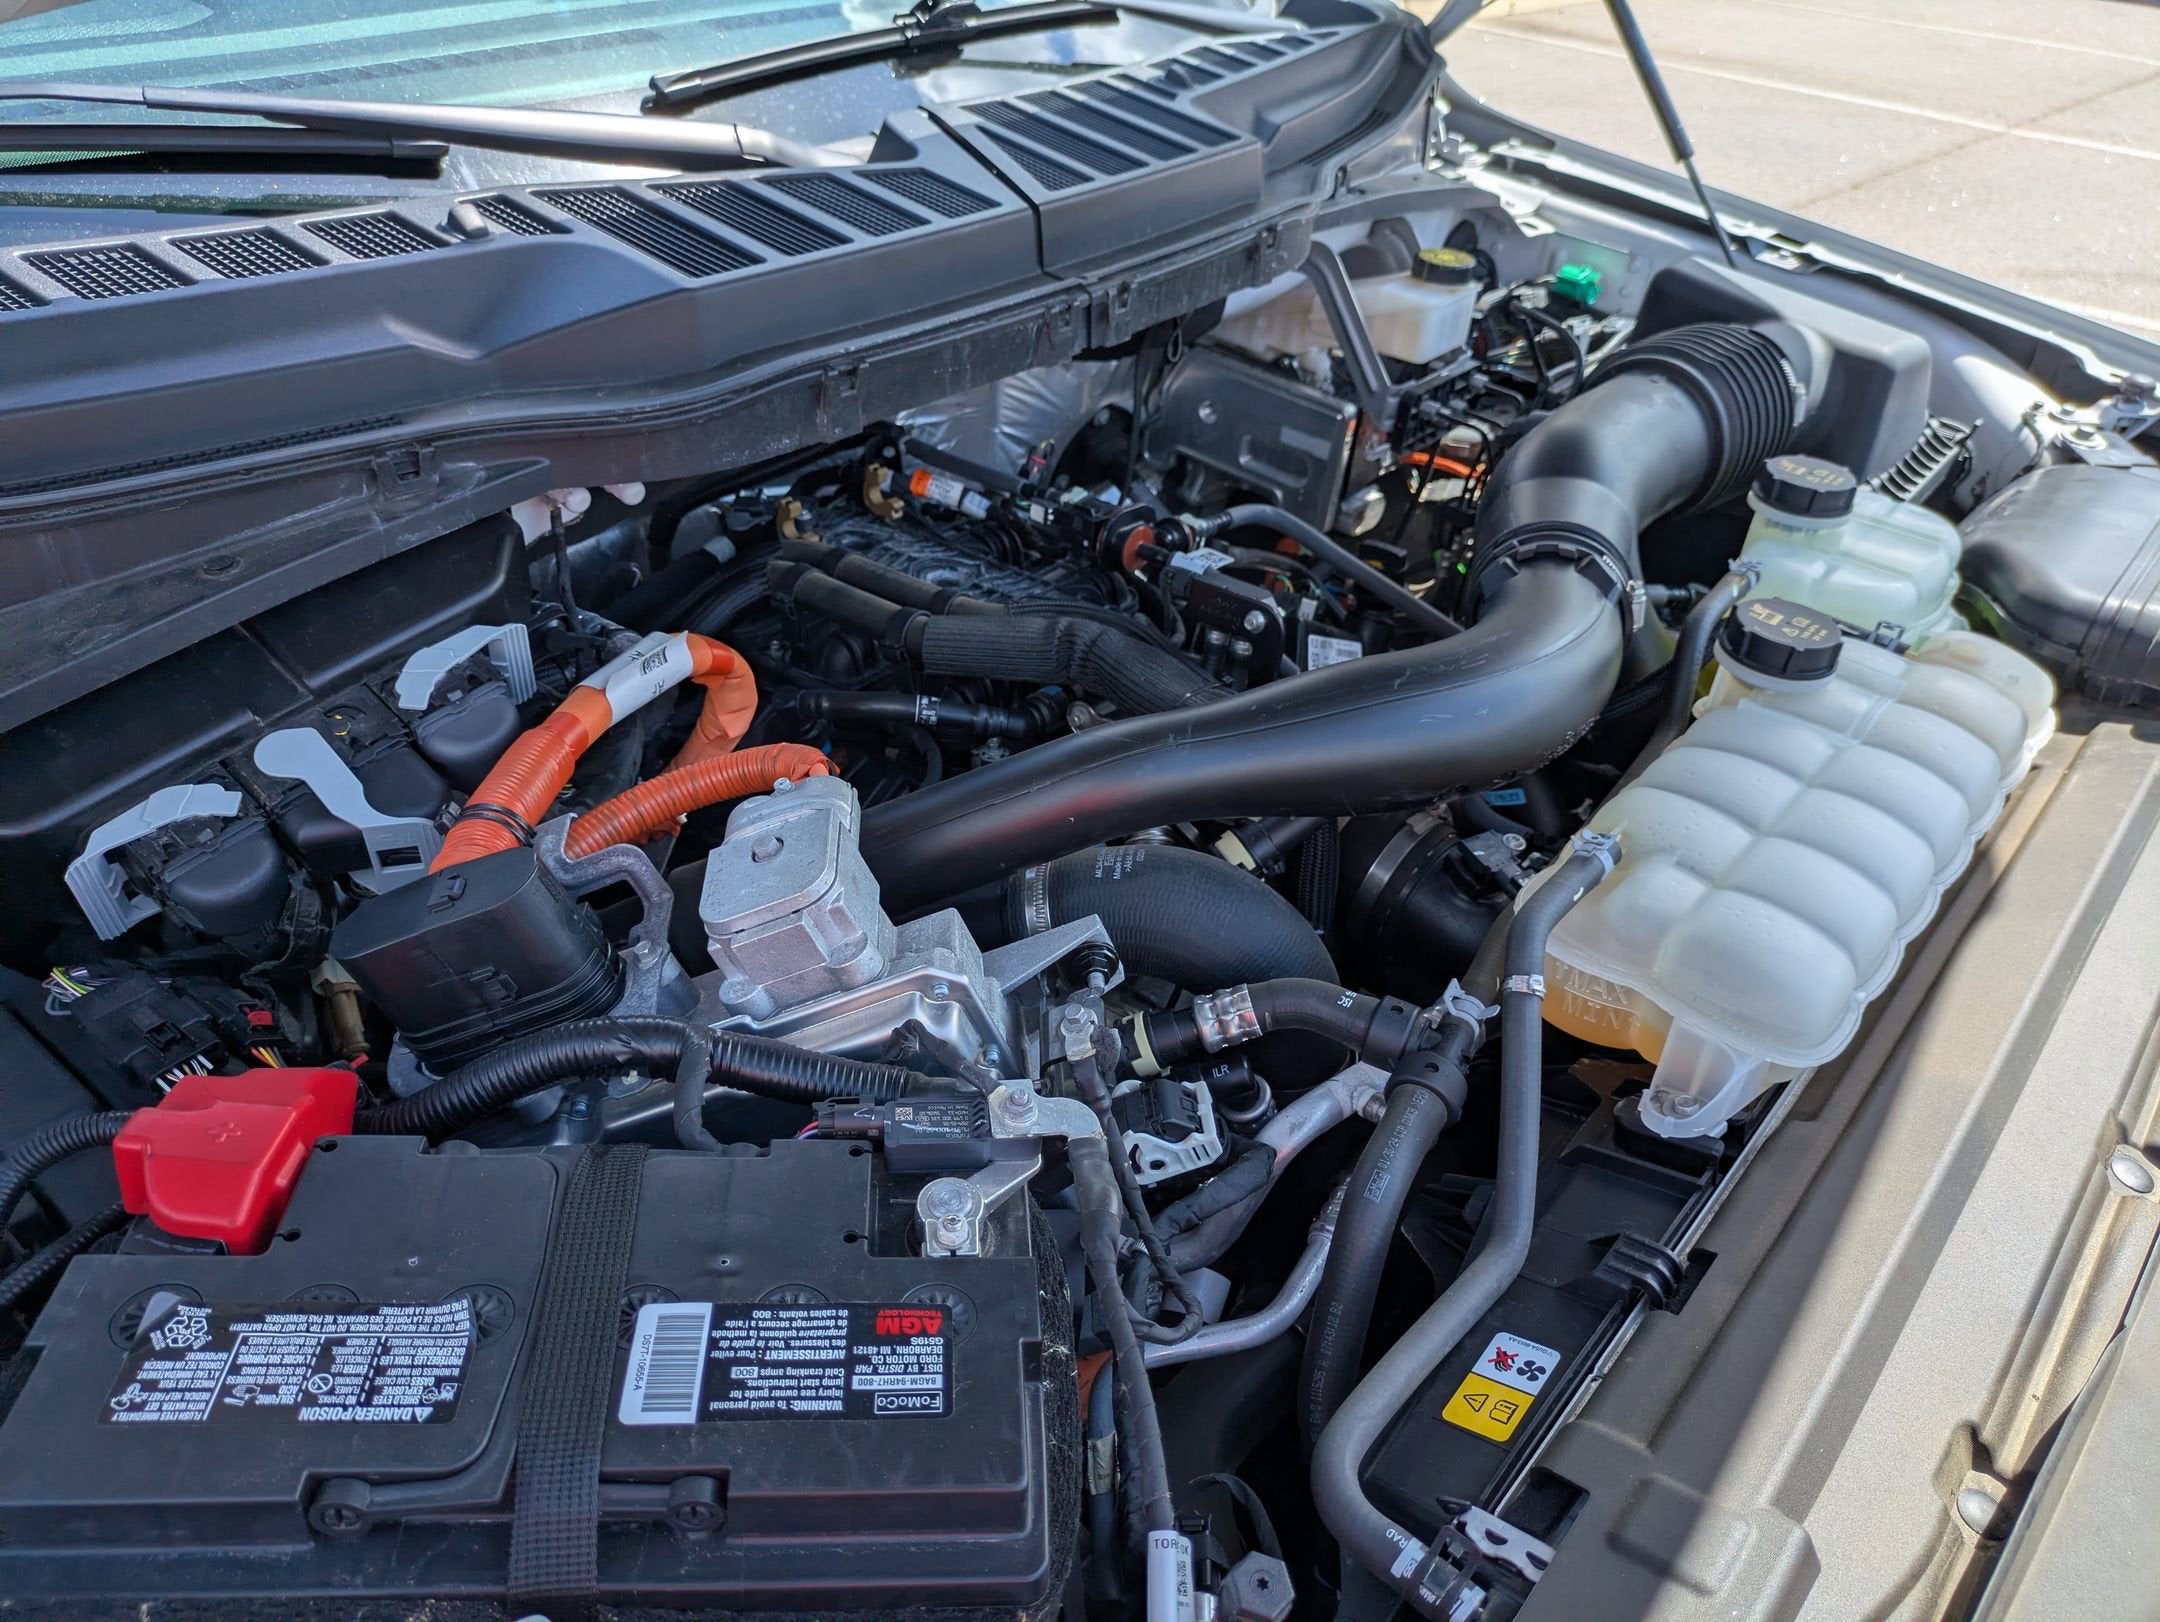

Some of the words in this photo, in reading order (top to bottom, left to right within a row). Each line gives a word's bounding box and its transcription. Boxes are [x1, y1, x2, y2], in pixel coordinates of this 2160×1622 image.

[1568, 969, 1628, 1004] MAX
[1562, 992, 1622, 1029] MIN
[1212, 1064, 1230, 1078] ILR
[379, 1306, 414, 1315] BATTERIE!
[415, 1307, 425, 1315] LA
[425, 1304, 450, 1314] OUVRIR
[837, 1309, 848, 1317] de
[877, 1309, 942, 1317] TECHNOLOGY
[752, 1310, 772, 1318] 800
[778, 1310, 808, 1318] volants
[810, 1309, 836, 1318] cables
[264, 1314, 308, 1322] RENVERSER.
[308, 1314, 323, 1322] PAS
[323, 1314, 334, 1322] NE
[422, 1315, 433, 1323] DE
[433, 1314, 453, 1322] HORS
[229, 1323, 263, 1331] BATTERY!
[262, 1323, 281, 1331] OPEN
[281, 1323, 296, 1331] NOT
[442, 1323, 455, 1331] OUT
[455, 1322, 470, 1331] KEEP
[725, 1320, 749, 1328] l'aide
[758, 1320, 790, 1328] secours
[837, 1319, 848, 1327] de
[876, 1317, 942, 1335] AGM
[297, 1323, 307, 1332] DO
[322, 1324, 336, 1332] NOT
[337, 1324, 348, 1332] DO
[384, 1324, 394, 1332] OF
[395, 1324, 417, 1332] REACH
[416, 1324, 430, 1332] THE
[431, 1323, 440, 1332] OF
[248, 1337, 272, 1345] GRAVES
[305, 1338, 318, 1346] DES
[346, 1338, 368, 1346] FUMER
[386, 1338, 412, 1346] AVEUGLE
[444, 1337, 468, 1346] BLESSER
[718, 1340, 730, 1348] du
[731, 1338, 756, 1348] guide
[756, 1340, 765, 1348] le
[767, 1340, 785, 1348] Voir
[788, 1339, 830, 1347] blessures.
[832, 1339, 846, 1347] des
[417, 1347, 452, 1355] EXPLOSIFS
[453, 1347, 466, 1355] GAZ
[853, 1346, 878, 1354] 48121
[880, 1346, 891, 1354] MI
[893, 1345, 942, 1354] DEARBORN,
[736, 1350, 756, 1358] Pour
[764, 1349, 846, 1360] AVERTISSEMENT
[236, 1354, 282, 1364] SULFURIQUE
[282, 1355, 311, 1364] L'ACIDE
[379, 1356, 393, 1365] LES
[393, 1356, 412, 1365] YEUX
[413, 1356, 425, 1365] LES
[869, 1355, 884, 1363] CO.
[886, 1355, 917, 1363] MOTOR
[920, 1355, 942, 1363] FORD
[175, 1361, 185, 1369] UN
[185, 1361, 225, 1369] CONSULTEZ
[330, 1364, 343, 1373] LES
[854, 1365, 873, 1373] PAR
[876, 1364, 904, 1372] DISTR.
[907, 1364, 918, 1372] BY
[921, 1364, 942, 1372] DIST.
[241, 1366, 267, 1374] BURNS
[267, 1366, 294, 1374] SEVERE
[296, 1366, 306, 1374] OR
[412, 1368, 422, 1376] OR
[423, 1367, 460, 1376] BLINDNESS
[735, 1368, 755, 1377] 800
[760, 1367, 784, 1376] amps
[786, 1367, 823, 1377] cranking
[825, 1368, 844, 1376] Cold
[158, 1380, 177, 1388] YEUX
[177, 1379, 191, 1388] LES
[191, 1379, 216, 1388] RINCEZ
[225, 1376, 264, 1384] BLINDNESS
[265, 1376, 287, 1384] CAUSE
[288, 1376, 302, 1384] CAN
[334, 1376, 364, 1384] SMOKING
[373, 1377, 396, 1385] CAUSE
[396, 1377, 410, 1385] CAN
[410, 1377, 435, 1385] GASES
[744, 1379, 798, 1388] instructions.
[800, 1378, 820, 1387] start
[822, 1377, 844, 1387] jump
[858, 1377, 936, 1386] BAGM-94RH7-800
[278, 1385, 300, 1394] ACID
[382, 1386, 423, 1395] EXPLOSIVE
[744, 1388, 769, 1398] guide
[818, 1388, 844, 1398] injury
[166, 1392, 183, 1400] HELP
[184, 1392, 211, 1400] MEDICAL
[729, 1390, 742, 1399] for
[255, 1394, 296, 1404] SULFURIC
[345, 1395, 357, 1404] NO
[372, 1395, 393, 1405] EYES
[393, 1395, 420, 1404] SHIELD
[877, 1396, 940, 1408] FoMoCo
[144, 1402, 160, 1411] GET
[187, 1401, 206, 1410] WITH
[709, 1400, 749, 1410] personal
[751, 1401, 775, 1410] avoid
[777, 1400, 788, 1410] To
[790, 1400, 843, 1410] WARNING:
[110, 1412, 160, 1422] IMMEDIATELY
[160, 1412, 178, 1421] EYES
[179, 1412, 202, 1421] FLUSH
[298, 1406, 413, 1421] DANGER/POISON
[1386, 1529, 1408, 1549] RAD
